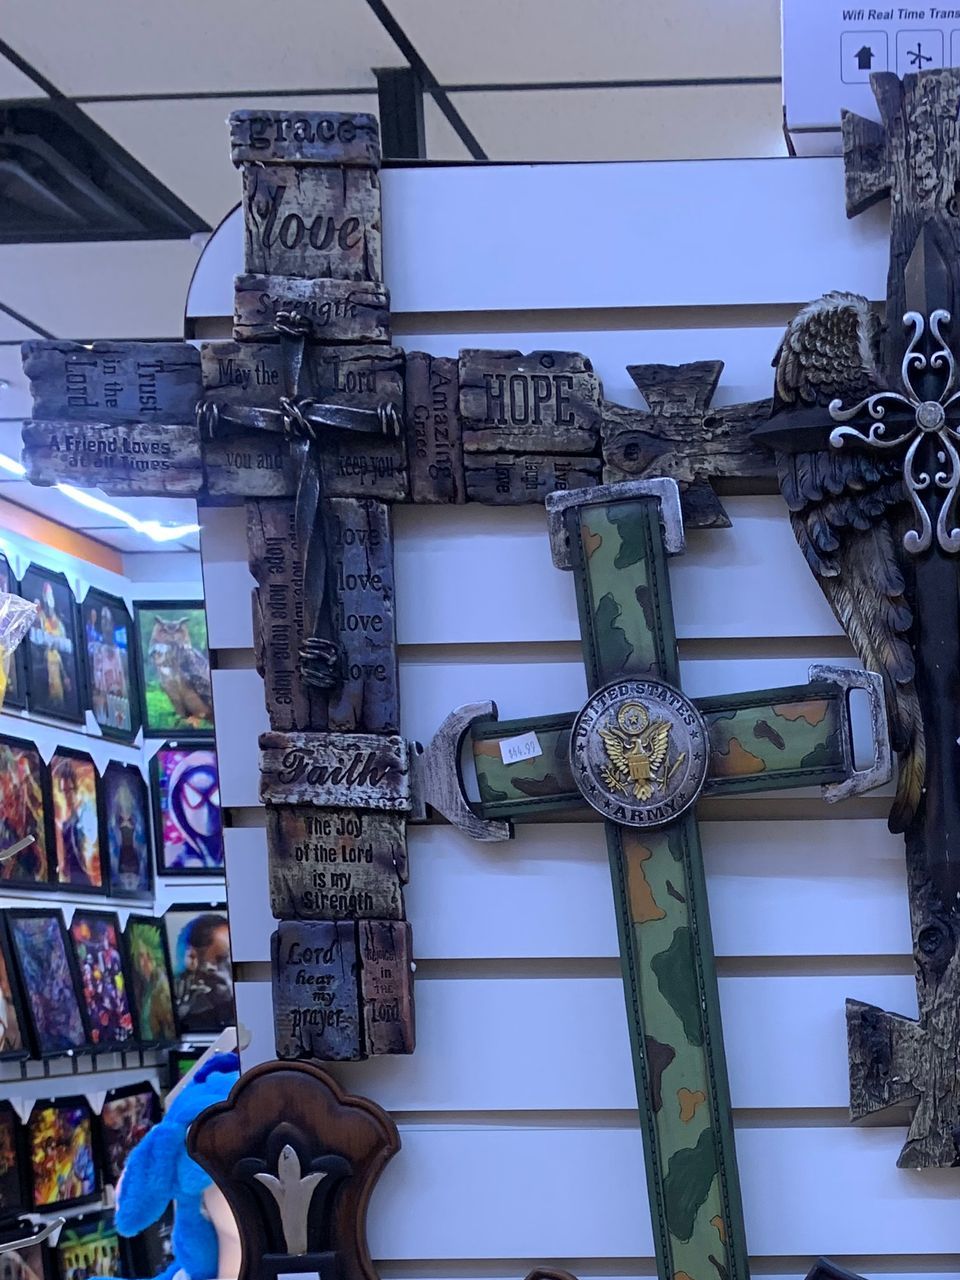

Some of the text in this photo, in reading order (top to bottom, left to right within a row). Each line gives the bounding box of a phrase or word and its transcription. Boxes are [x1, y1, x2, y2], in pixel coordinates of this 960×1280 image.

[841, 9, 865, 21] Wifi
[867, 9, 894, 21] Real
[898, 8, 926, 20] Time
[248, 118, 358, 150] grace
[260, 184, 363, 251] love
[65, 360, 99, 408] Lord
[103, 359, 124, 409] in the
[137, 359, 163, 413] Trust
[217, 359, 280, 391] May the
[331, 356, 378, 394] Lord
[483, 374, 576, 427] HOPE
[413, 404, 431, 459] Grace
[428, 371, 455, 482] Amazing
[66, 435, 118, 453] Friend
[123, 437, 171, 456] Loves
[120, 456, 171, 472] Times
[335, 515, 381, 548] love
[336, 560, 383, 593] love
[263, 537, 295, 706] hope hope hope hope
[337, 601, 384, 633] love
[341, 651, 388, 682] love
[577, 683, 696, 738] UNITED STATES
[277, 749, 391, 787] Faith
[612, 800, 679, 822] ARMY
[304, 816, 363, 839] The Joy
[294, 843, 373, 864] of the Lord
[312, 869, 352, 892] is my
[303, 889, 374, 912] Strength
[286, 939, 340, 966] Lord
[295, 969, 336, 985] hear
[380, 966, 392, 979] in
[312, 991, 336, 1006] my
[290, 1008, 344, 1038] prayer
